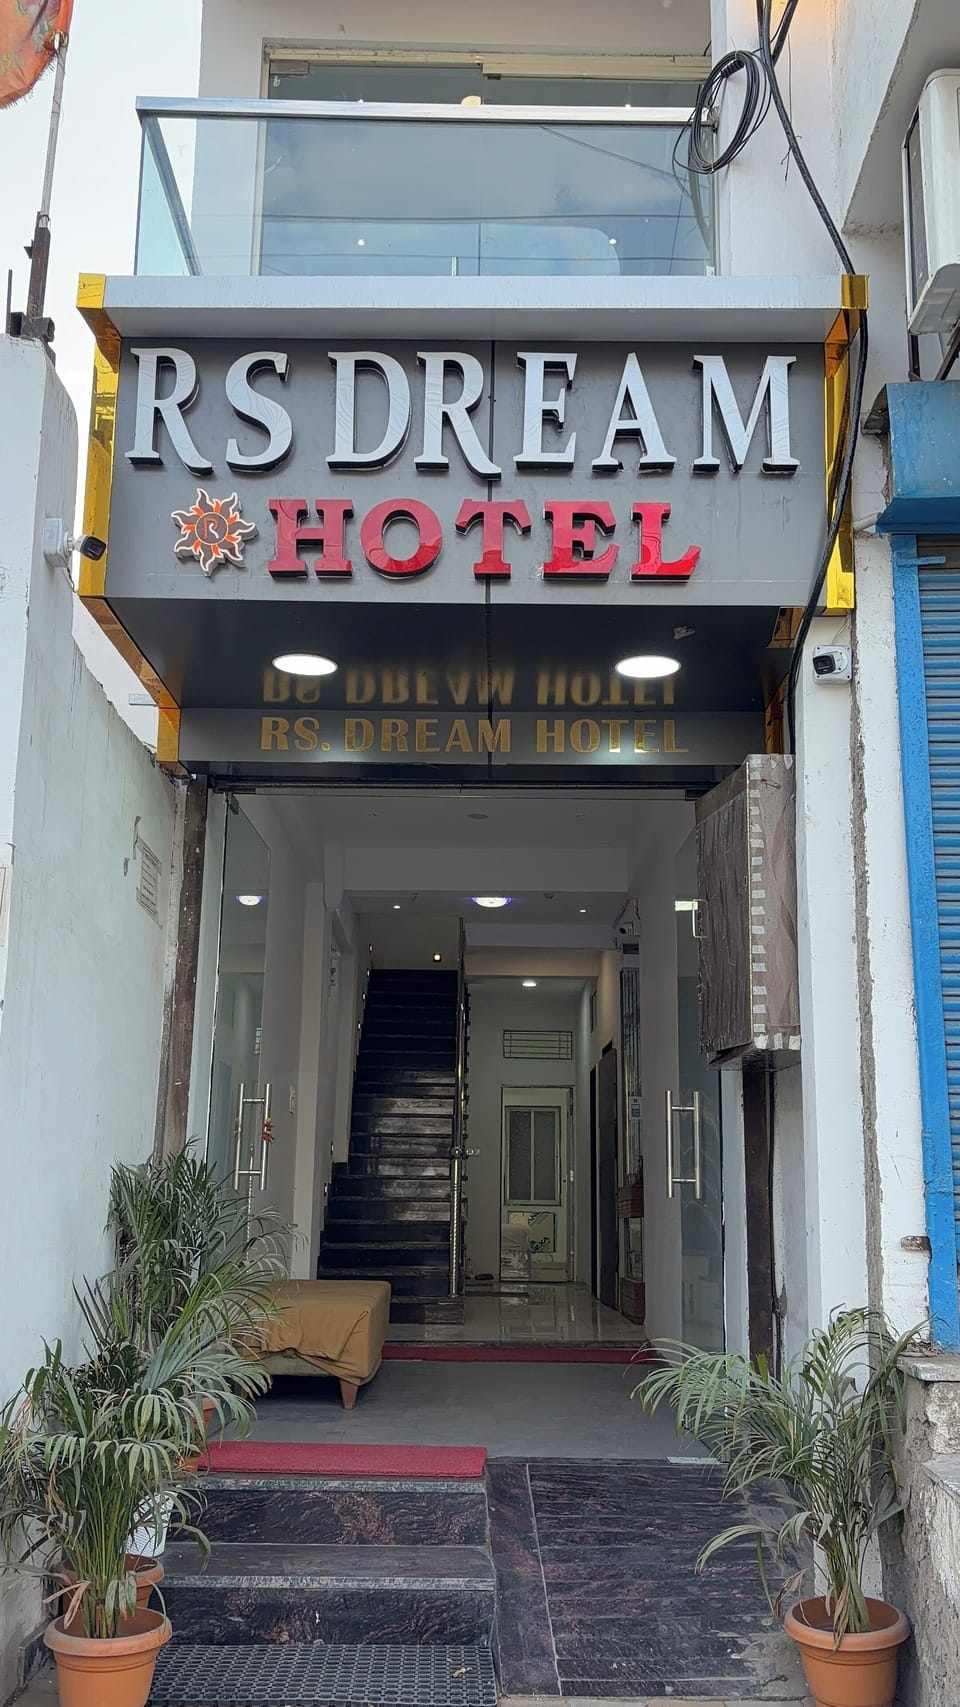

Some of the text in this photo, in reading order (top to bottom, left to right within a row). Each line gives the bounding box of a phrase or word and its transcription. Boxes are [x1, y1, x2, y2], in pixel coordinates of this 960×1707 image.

[124, 347, 801, 479] RS DREAM
[268, 498, 701, 582] HOTEL
[261, 716, 689, 753] RS. DREAM HOTEL
